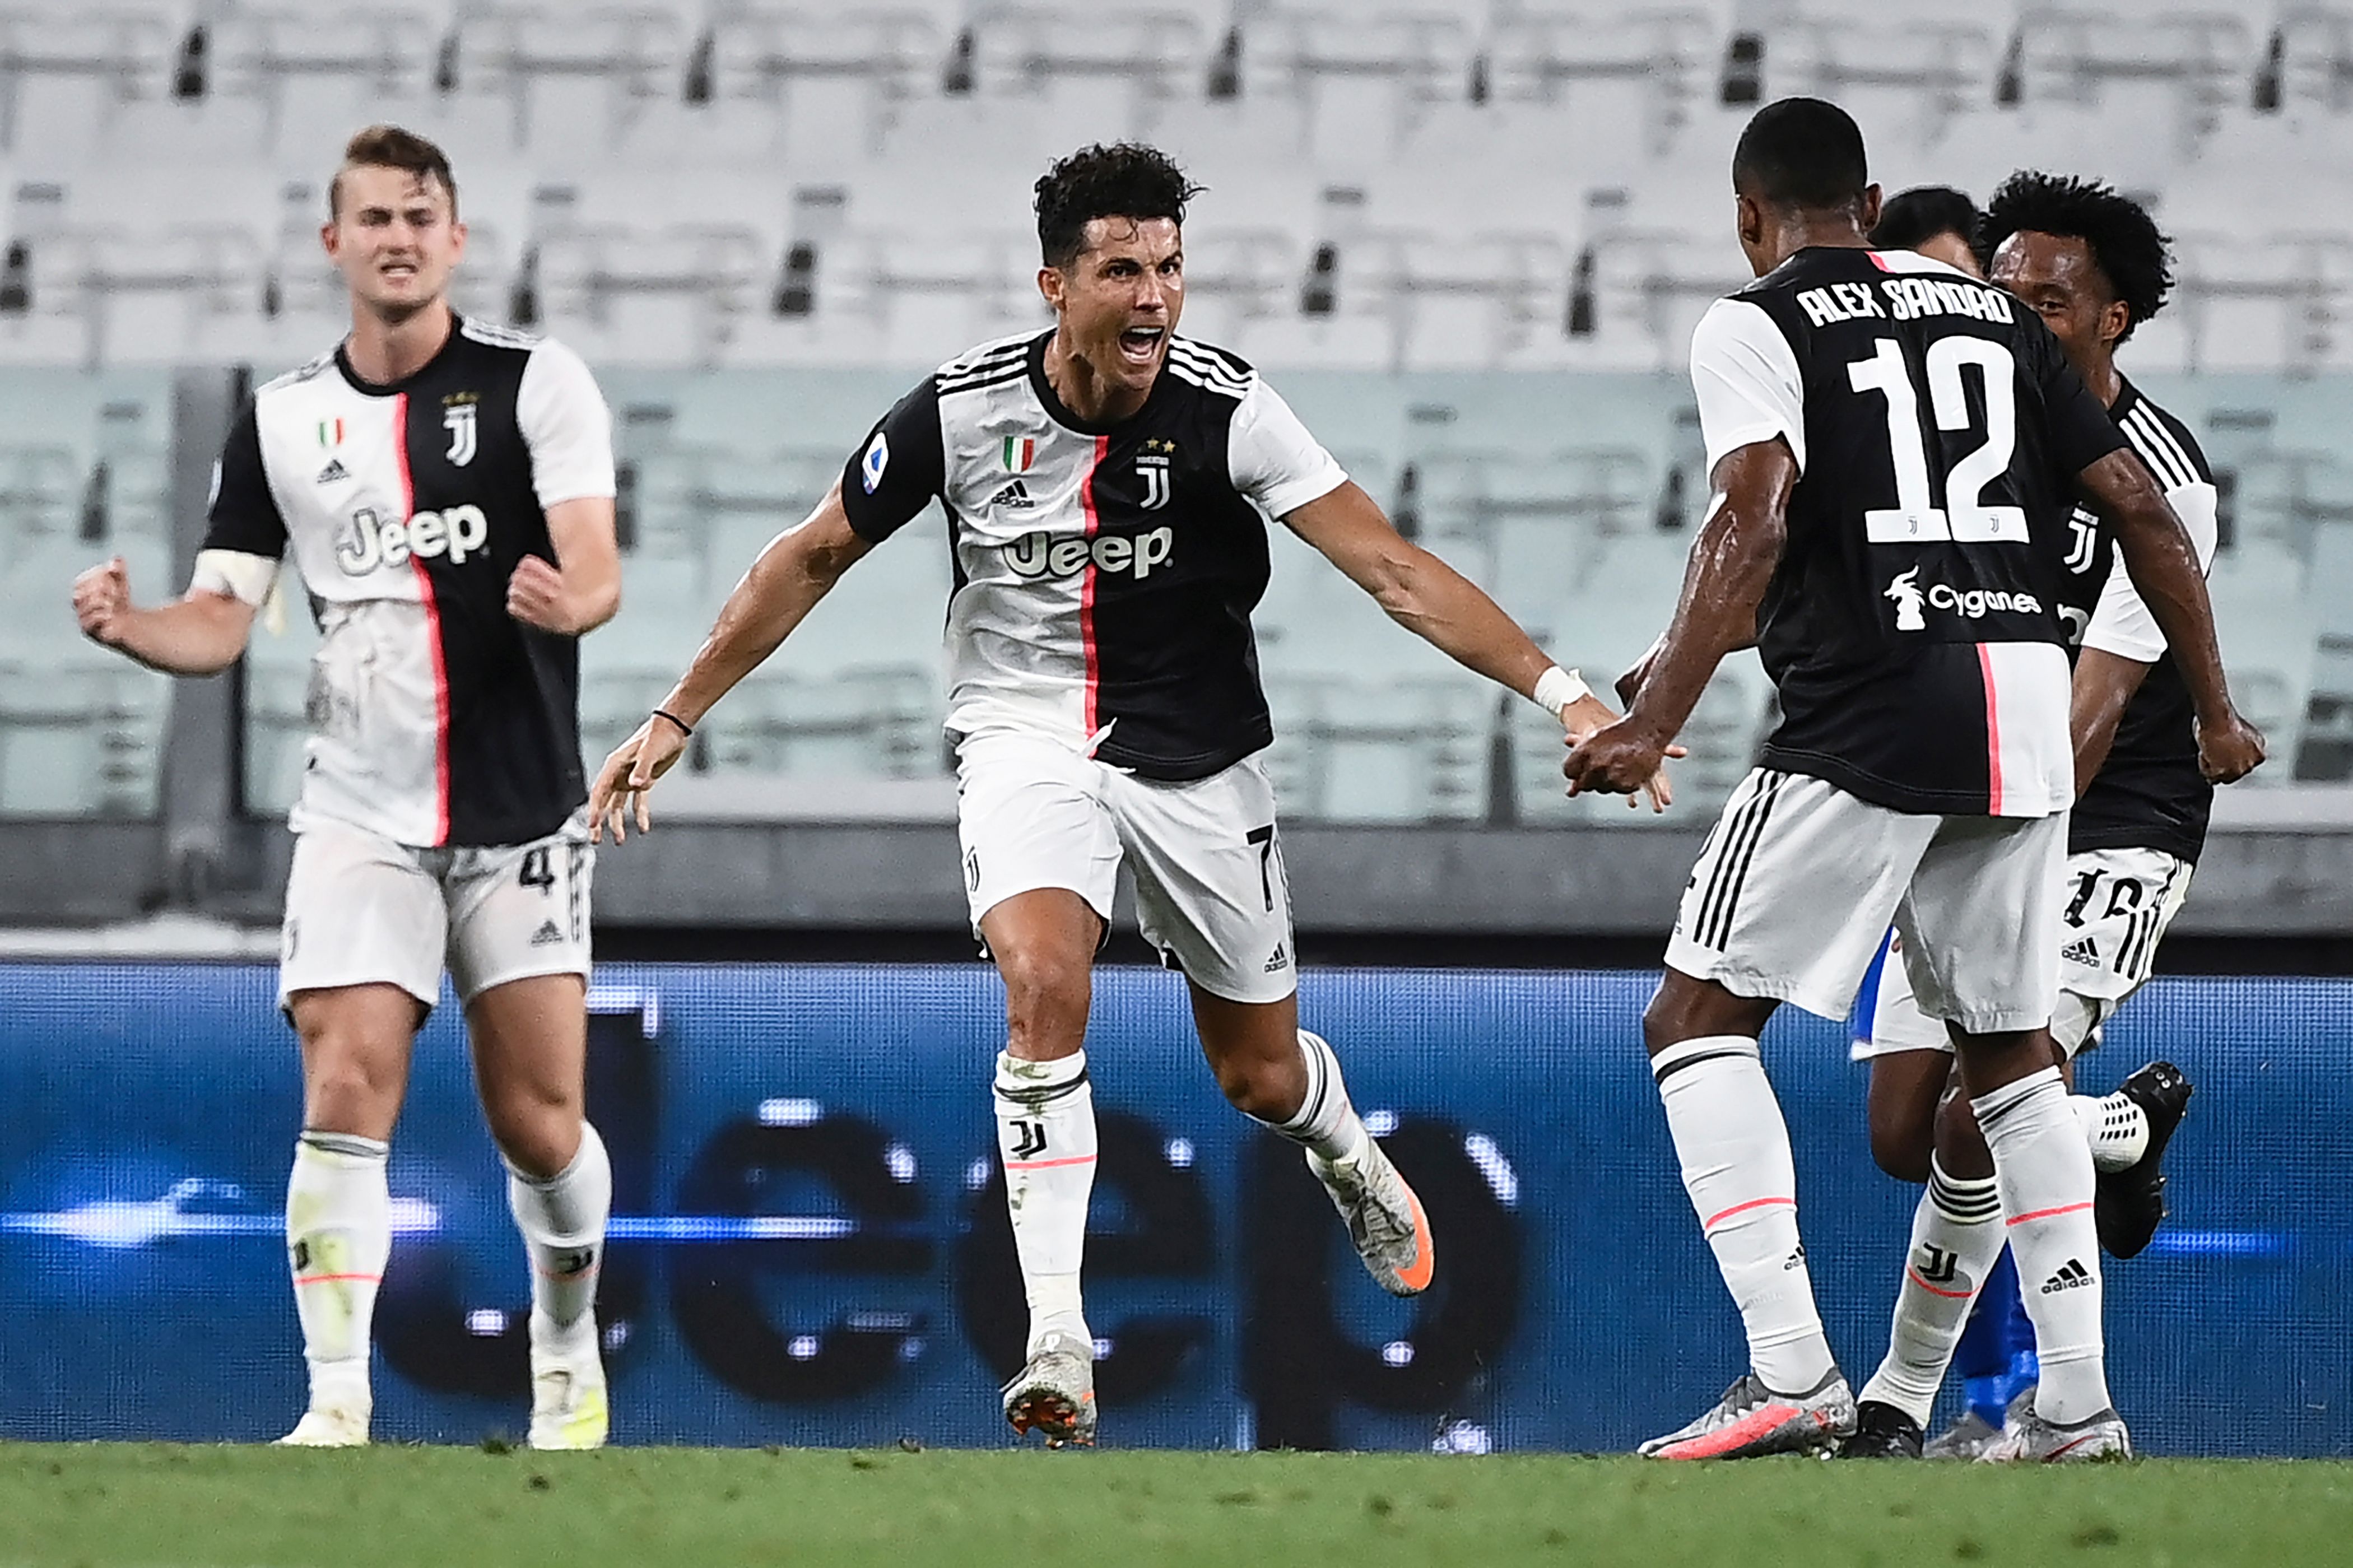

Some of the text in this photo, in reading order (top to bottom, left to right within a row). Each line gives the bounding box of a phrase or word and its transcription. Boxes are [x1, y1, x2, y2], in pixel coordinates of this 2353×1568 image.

[1796, 278, 2014, 327] ALEX SANDRO
[1847, 336, 2031, 544] 12
[336, 502, 489, 577] Jeep
[1002, 525, 1173, 580] Jeep
[519, 846, 555, 896] 4
[1246, 824, 1274, 913] 7
[2040, 1277, 2096, 1295] adidas
